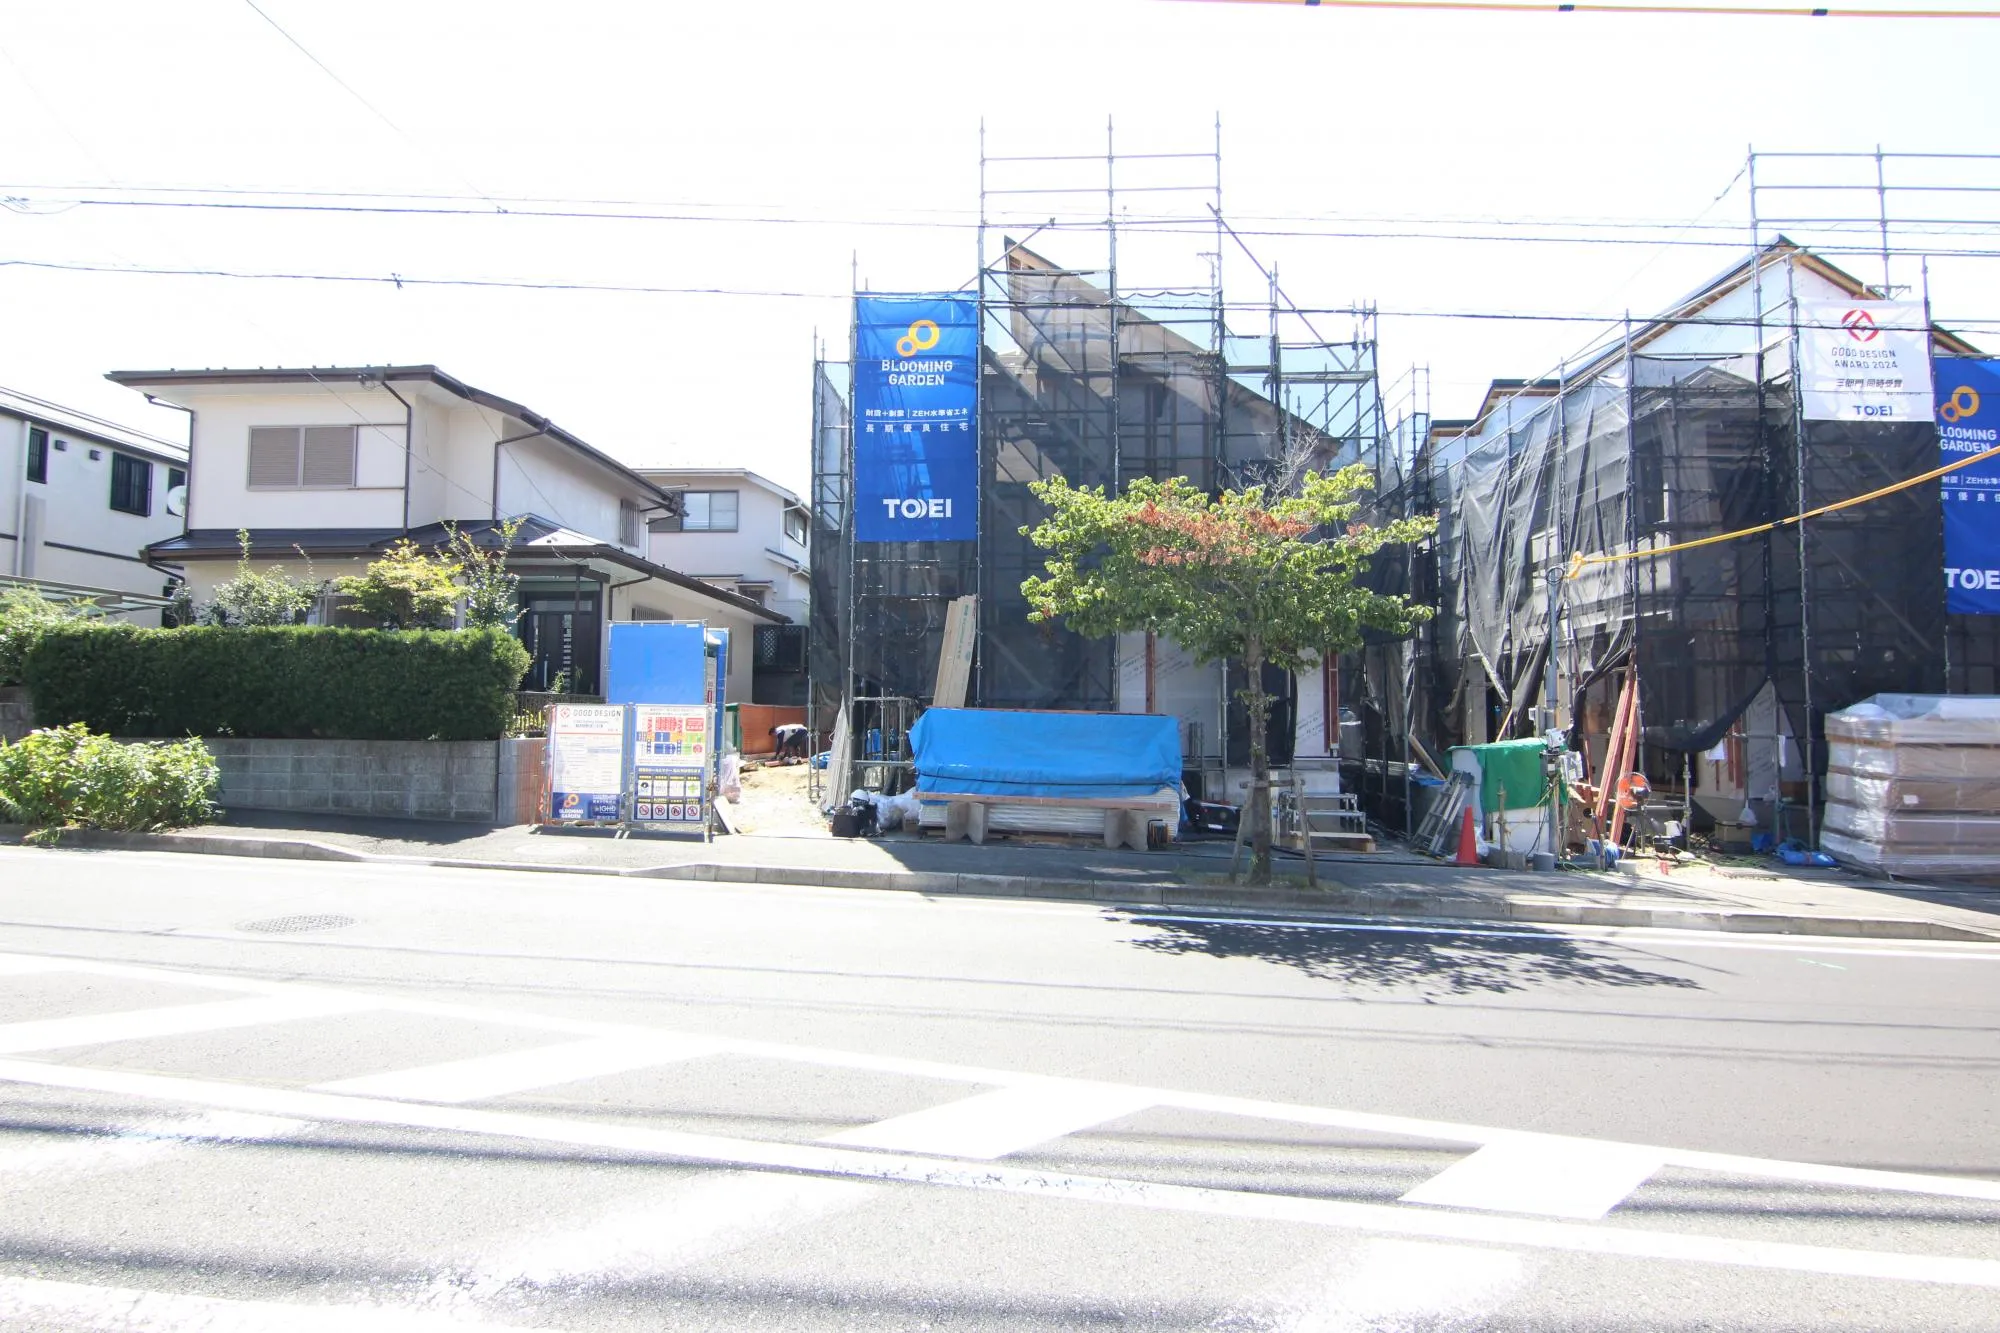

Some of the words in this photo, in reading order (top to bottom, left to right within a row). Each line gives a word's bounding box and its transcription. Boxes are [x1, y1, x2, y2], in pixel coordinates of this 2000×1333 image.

[1831, 346, 1857, 357] GOOD
[1859, 349, 1897, 359] DESIGN
[881, 359, 953, 373] BLOOMING
[1834, 359, 1870, 369] AWARD
[1871, 360, 1899, 369] 2024
[888, 373, 945, 386] GARDEN
[1940, 438, 1991, 453] GARDEN
[573, 709, 592, 717] GOOD
[594, 709, 622, 717] DESIGN
